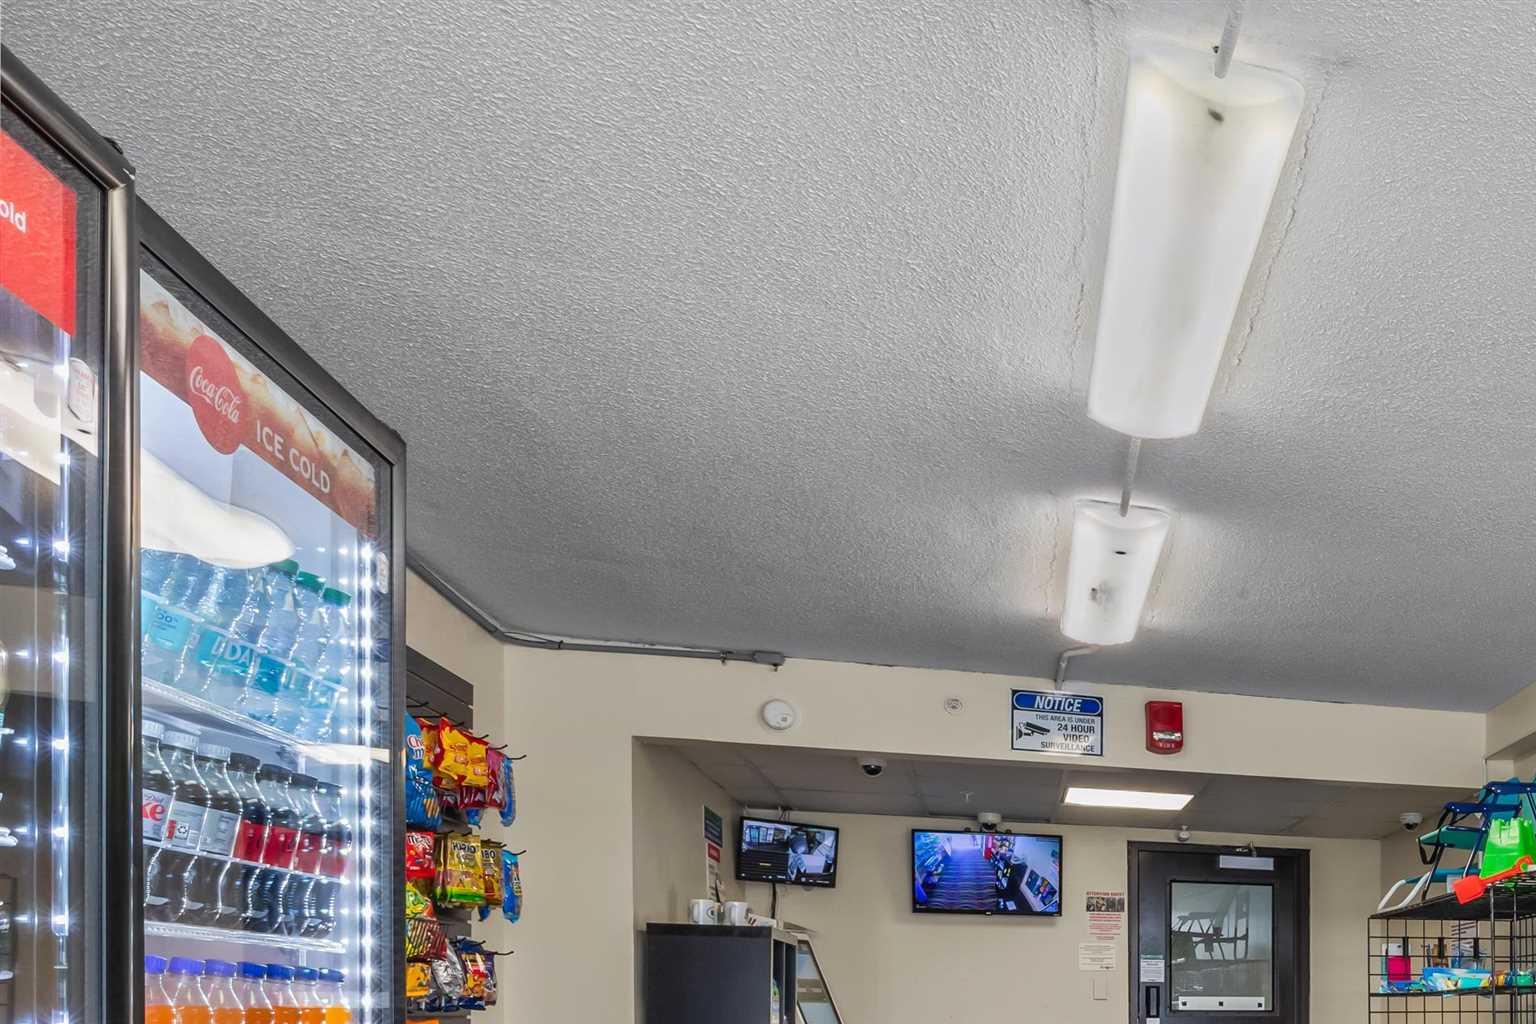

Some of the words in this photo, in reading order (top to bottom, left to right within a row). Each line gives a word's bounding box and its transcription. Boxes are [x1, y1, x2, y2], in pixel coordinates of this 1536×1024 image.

[189, 366, 240, 425] Coca-Cola
[256, 418, 285, 462] ICE
[288, 448, 332, 494] COLD
[1034, 695, 1082, 713] NOTICE
[1050, 715, 1066, 723] AREA
[1074, 717, 1095, 725] UNDER
[1057, 723, 1068, 732] 24
[1070, 724, 1095, 734] HOUR
[1063, 733, 1089, 742] VIDEO
[1041, 741, 1095, 752] SURVEILLANCE
